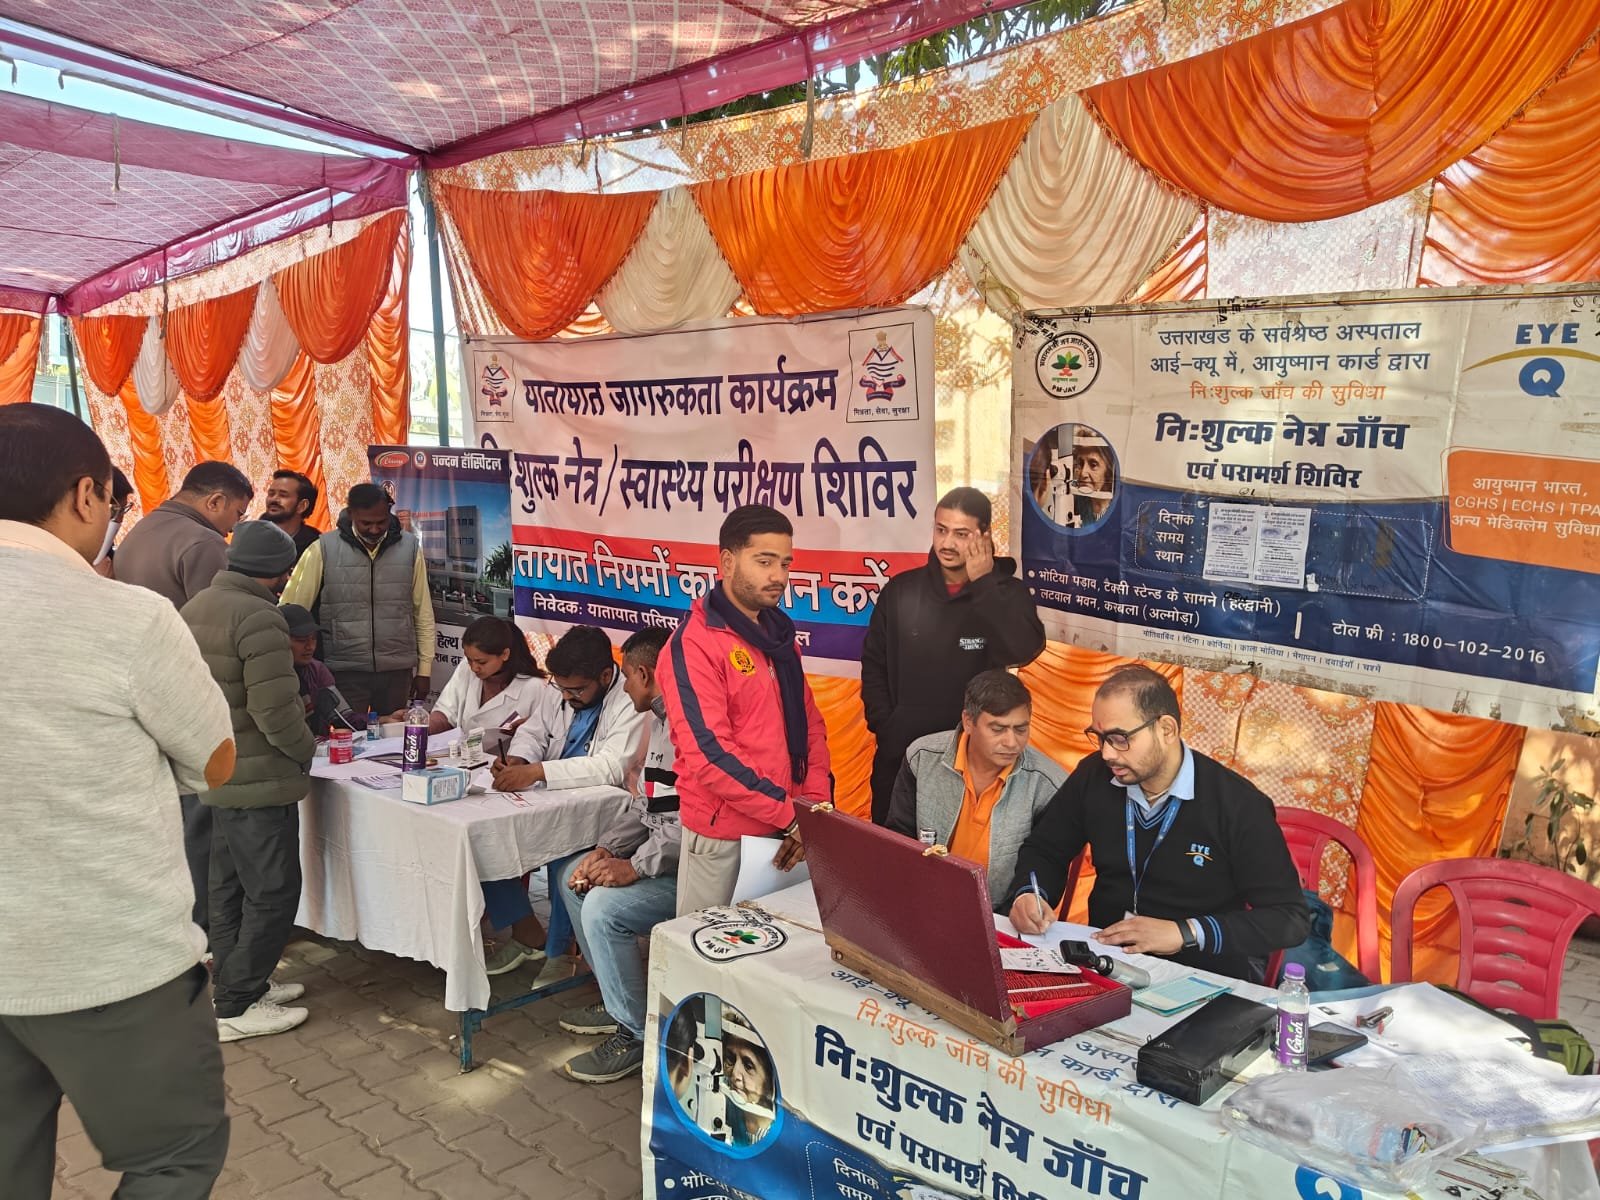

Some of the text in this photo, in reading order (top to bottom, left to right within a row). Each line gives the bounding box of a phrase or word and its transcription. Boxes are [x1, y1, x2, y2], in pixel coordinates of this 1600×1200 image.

[1158, 321, 1421, 346] उत्तराखंड के सर्वश्रेष्ठ अस्पताल
[1515, 323, 1580, 344] EYE
[1224, 351, 1245, 374] में,
[1253, 354, 1329, 378] आयुष्मान
[1338, 347, 1381, 371] कार्ड
[1388, 353, 1431, 371] द्वारा
[522, 355, 839, 416] यातायात जागरुकता कार्यक्रम
[1518, 357, 1565, 397] Q
[1302, 380, 1323, 400] की
[1331, 380, 1386, 406] सुविधा
[1283, 414, 1330, 447] नेत्र
[1336, 416, 1410, 449] जाँच
[432, 452, 501, 471] चन्दन हॉस्पिटल
[1186, 458, 1362, 488] एवं परामर्श शिविर
[564, 436, 602, 505] नेत्र
[620, 459, 708, 512] स्वास्थ्य
[714, 439, 804, 517] परीक्षण
[811, 436, 917, 519] शिविर
[1473, 478, 1588, 497] आयुष्मान भारत,
[1158, 508, 1196, 526] दिनांक
[1455, 496, 1498, 510] CGHS
[1512, 499, 1555, 513] ECHS
[1570, 502, 1600, 517] TPA
[1451, 514, 1481, 528] अन्य
[1487, 513, 1548, 533] मेडिक्लेम
[1156, 531, 1184, 544] समय
[592, 539, 670, 597] नियमों
[1154, 550, 1184, 563] स्थान
[1039, 569, 1069, 585] भोटिया
[1166, 587, 1178, 602] के
[1183, 591, 1217, 608] सामने
[1040, 588, 1072, 604] लटवाल
[1104, 601, 1139, 616] करबला
[587, 603, 638, 624] यातायात
[1332, 619, 1360, 638] टोल
[1365, 623, 1384, 641] फ्री
[1190, 843, 1210, 856] EYE
[1193, 855, 1204, 867] Q
[1060, 1054, 1124, 1082] कार्ड
[998, 1057, 1027, 1091] की
[1036, 1079, 1112, 1126] सुविधा
[976, 1091, 1035, 1163] नेत्र
[856, 1112, 896, 1150] एवं
[900, 1131, 988, 1194] परामर्श
[833, 1157, 879, 1190] दिनांक
